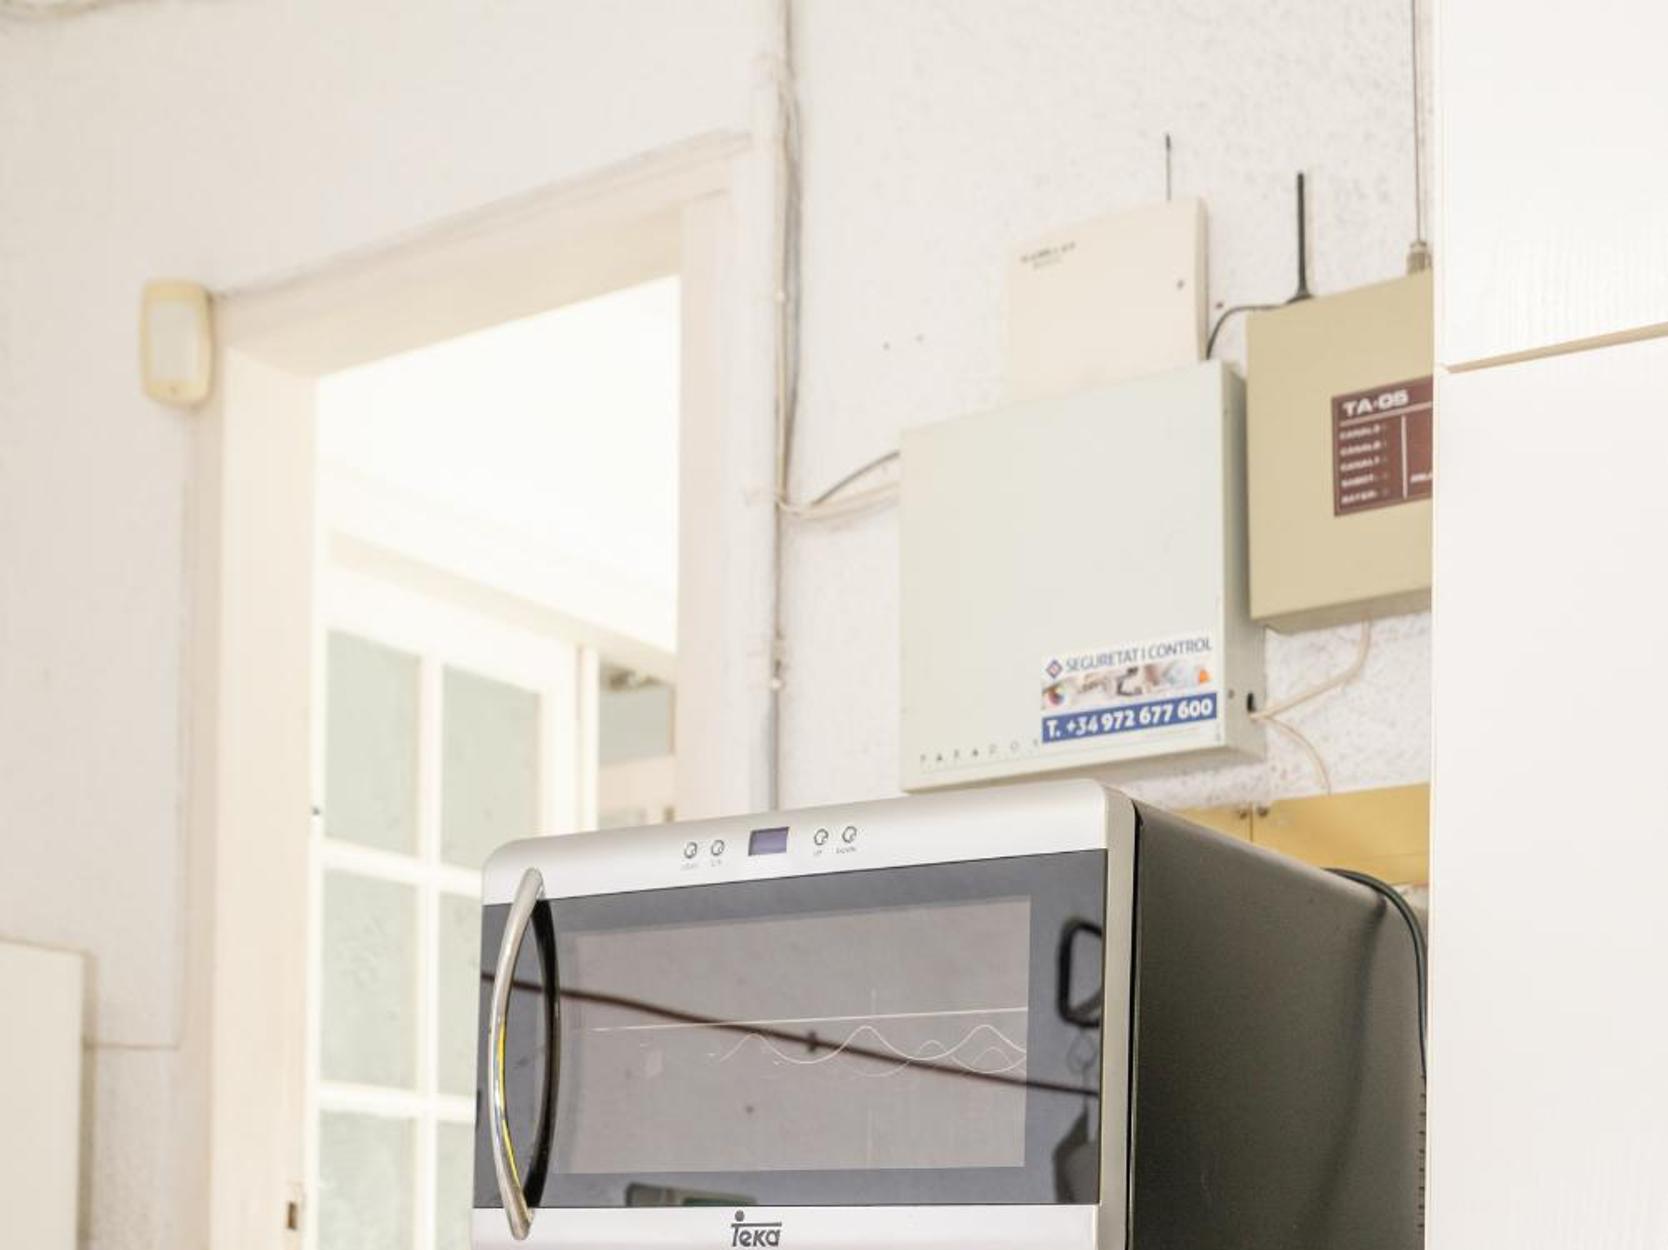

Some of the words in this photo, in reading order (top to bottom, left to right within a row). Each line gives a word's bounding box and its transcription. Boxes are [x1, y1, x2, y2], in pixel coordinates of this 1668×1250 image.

[1066, 649, 1139, 672] SEGURETAT
[1149, 637, 1212, 660] CONTROL
[1046, 720, 1061, 738] T.
[1066, 715, 1098, 736] +34
[1101, 710, 1135, 731] 972
[1139, 703, 1174, 725] 677
[1177, 698, 1213, 719] 600
